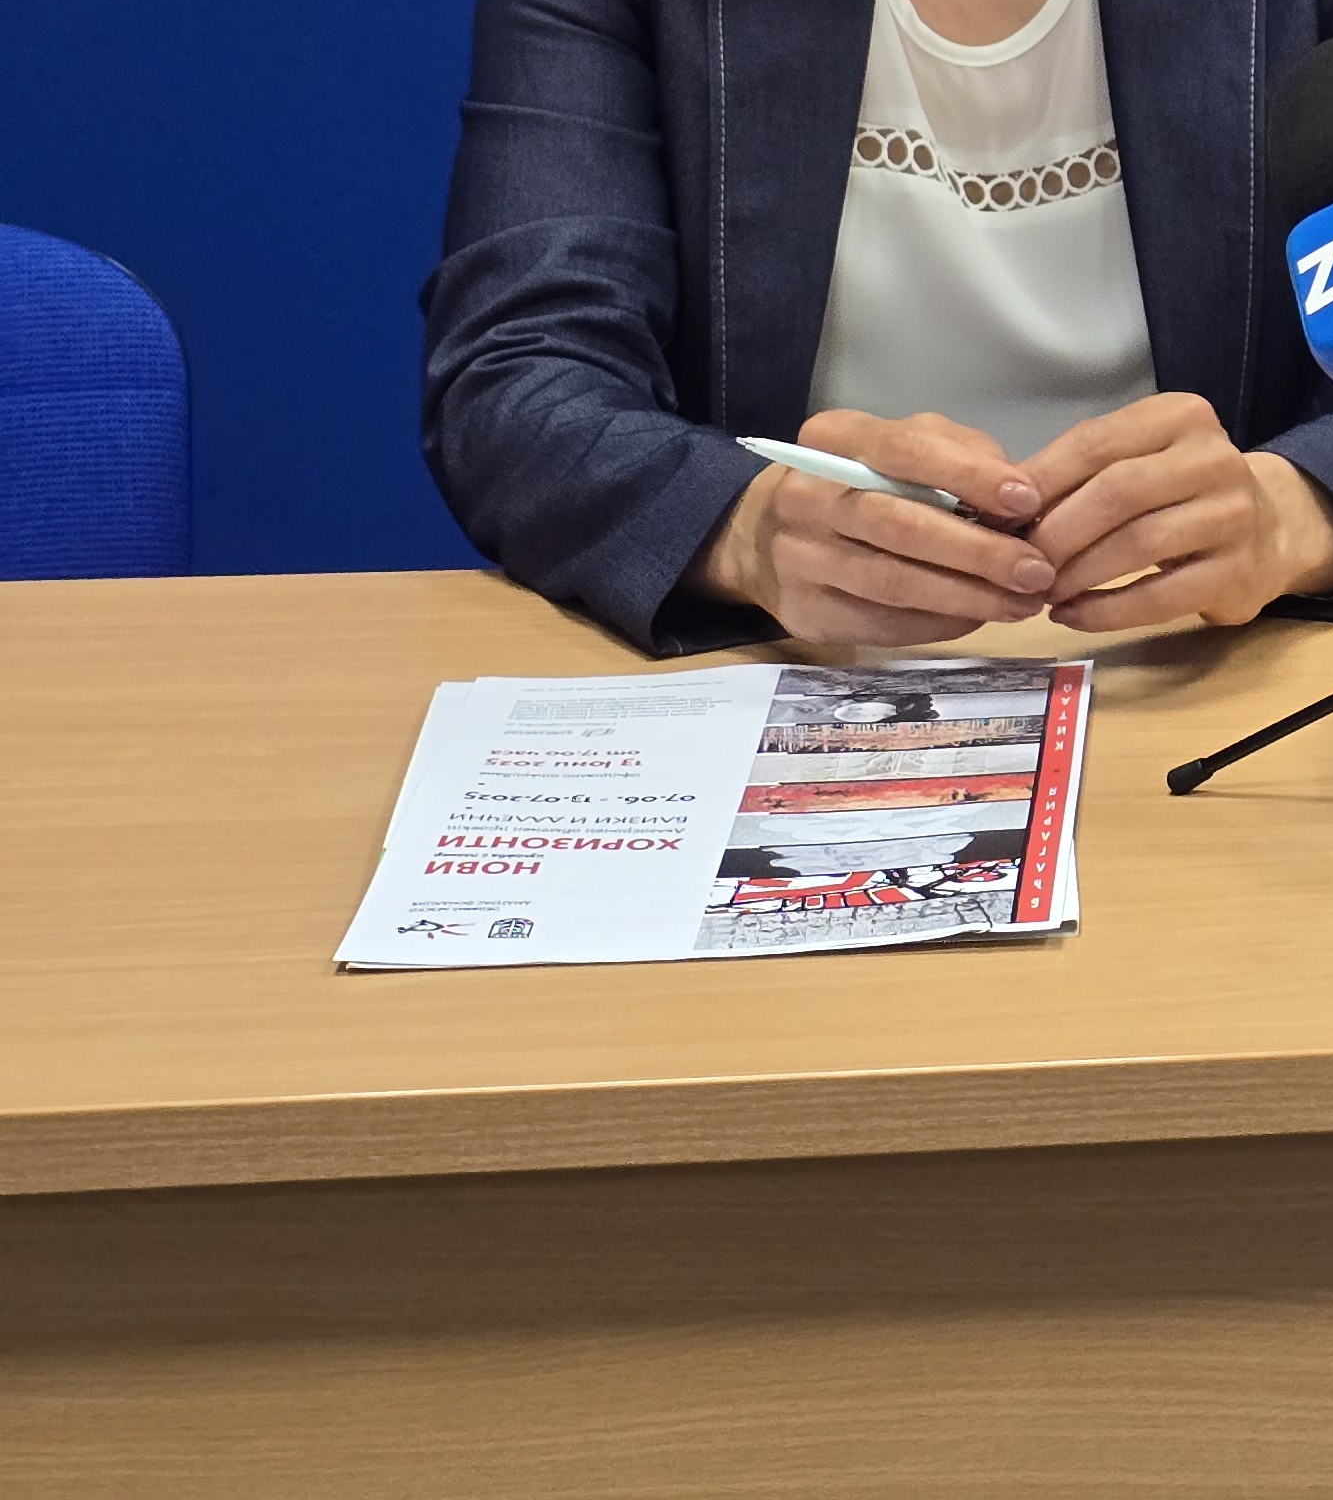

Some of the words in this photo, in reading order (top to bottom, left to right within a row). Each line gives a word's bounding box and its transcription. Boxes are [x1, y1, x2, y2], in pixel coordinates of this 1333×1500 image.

[616, 794, 697, 804] 07.06.
[436, 835, 684, 851] ХОРИЗОНТИ
[424, 861, 542, 875] НОВИ
